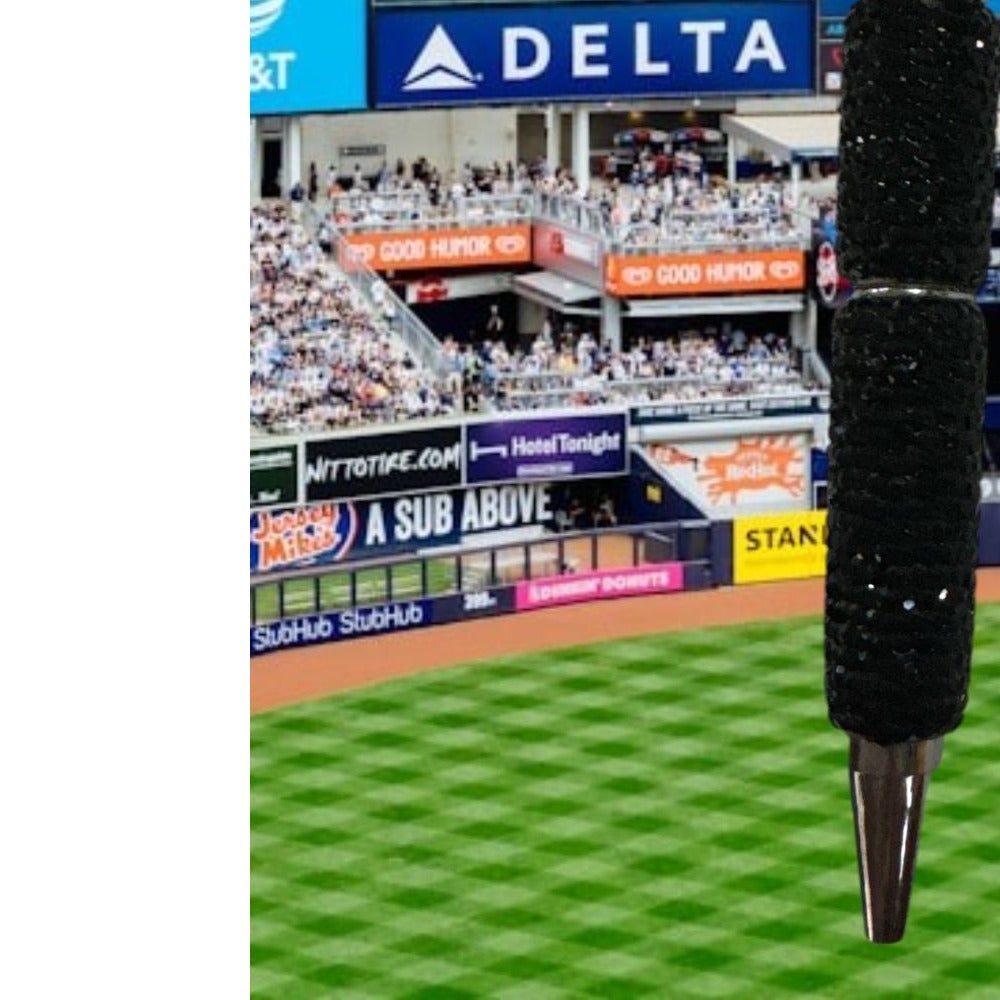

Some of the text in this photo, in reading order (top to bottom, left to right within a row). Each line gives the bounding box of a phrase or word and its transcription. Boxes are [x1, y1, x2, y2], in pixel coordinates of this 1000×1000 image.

[503, 19, 788, 82] DELTA
[379, 234, 493, 262] GOOD HUMOR
[655, 260, 767, 285] GOOD HUMOR
[511, 432, 621, 457] HotelTonight
[306, 443, 461, 485] NITTOTIRE.COM
[366, 485, 554, 545] A SUB ABOVE
[602, 570, 670, 592] DONUTS
[252, 601, 423, 651] StubHub StubHub
